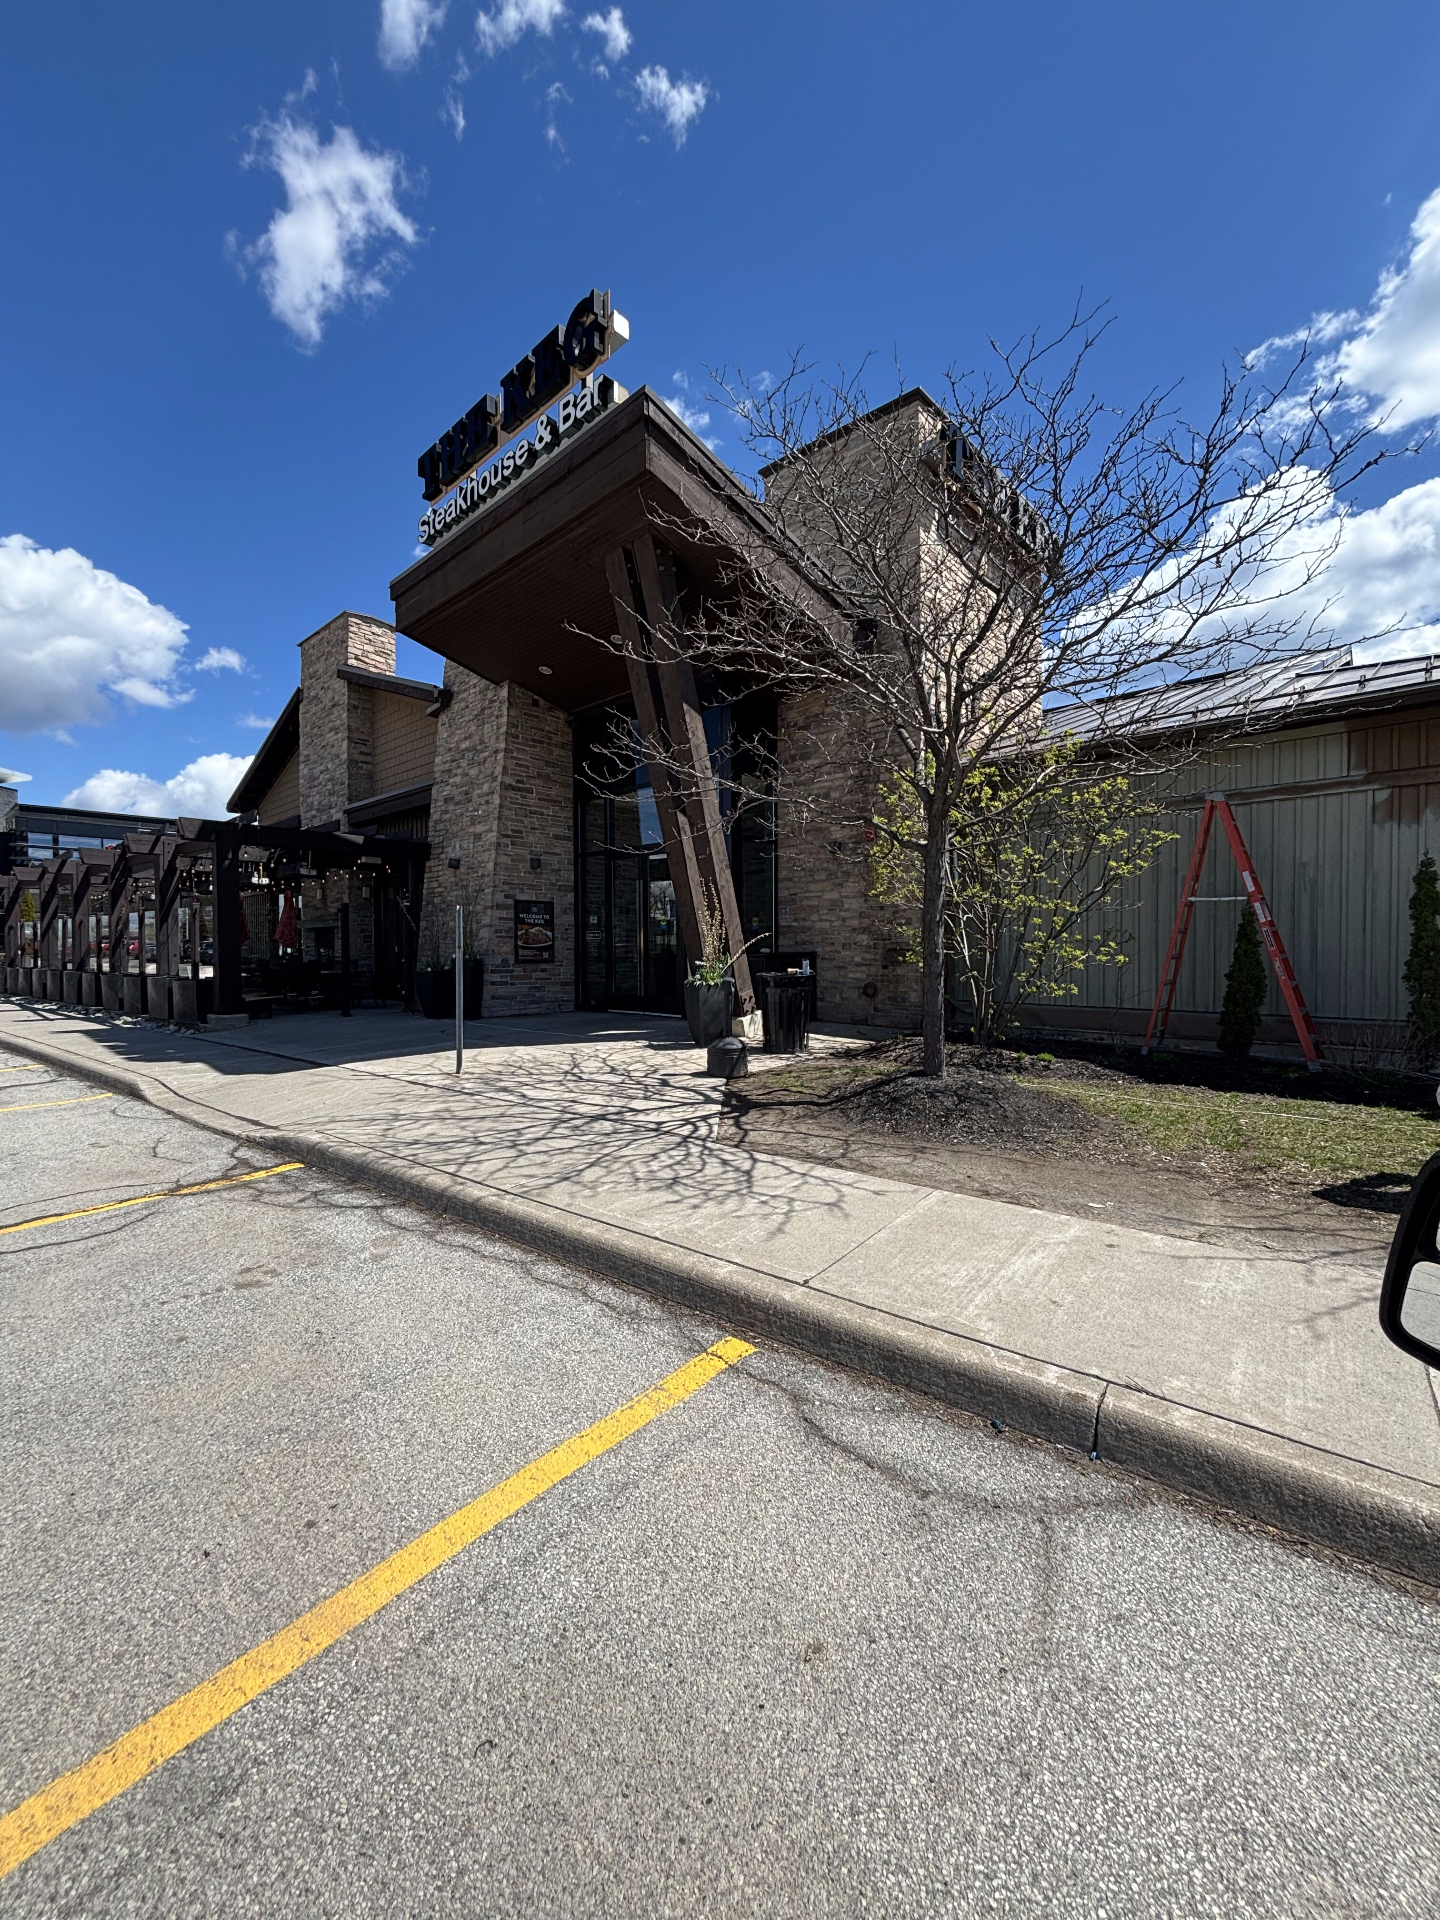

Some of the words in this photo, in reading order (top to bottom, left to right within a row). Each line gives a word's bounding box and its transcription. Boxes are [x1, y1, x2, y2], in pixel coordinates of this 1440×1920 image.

[417, 439, 532, 544] Steakhouse
[534, 413, 557, 451] &
[558, 373, 610, 439] Bar
[418, 394, 499, 502] THE
[500, 288, 610, 434] KEG
